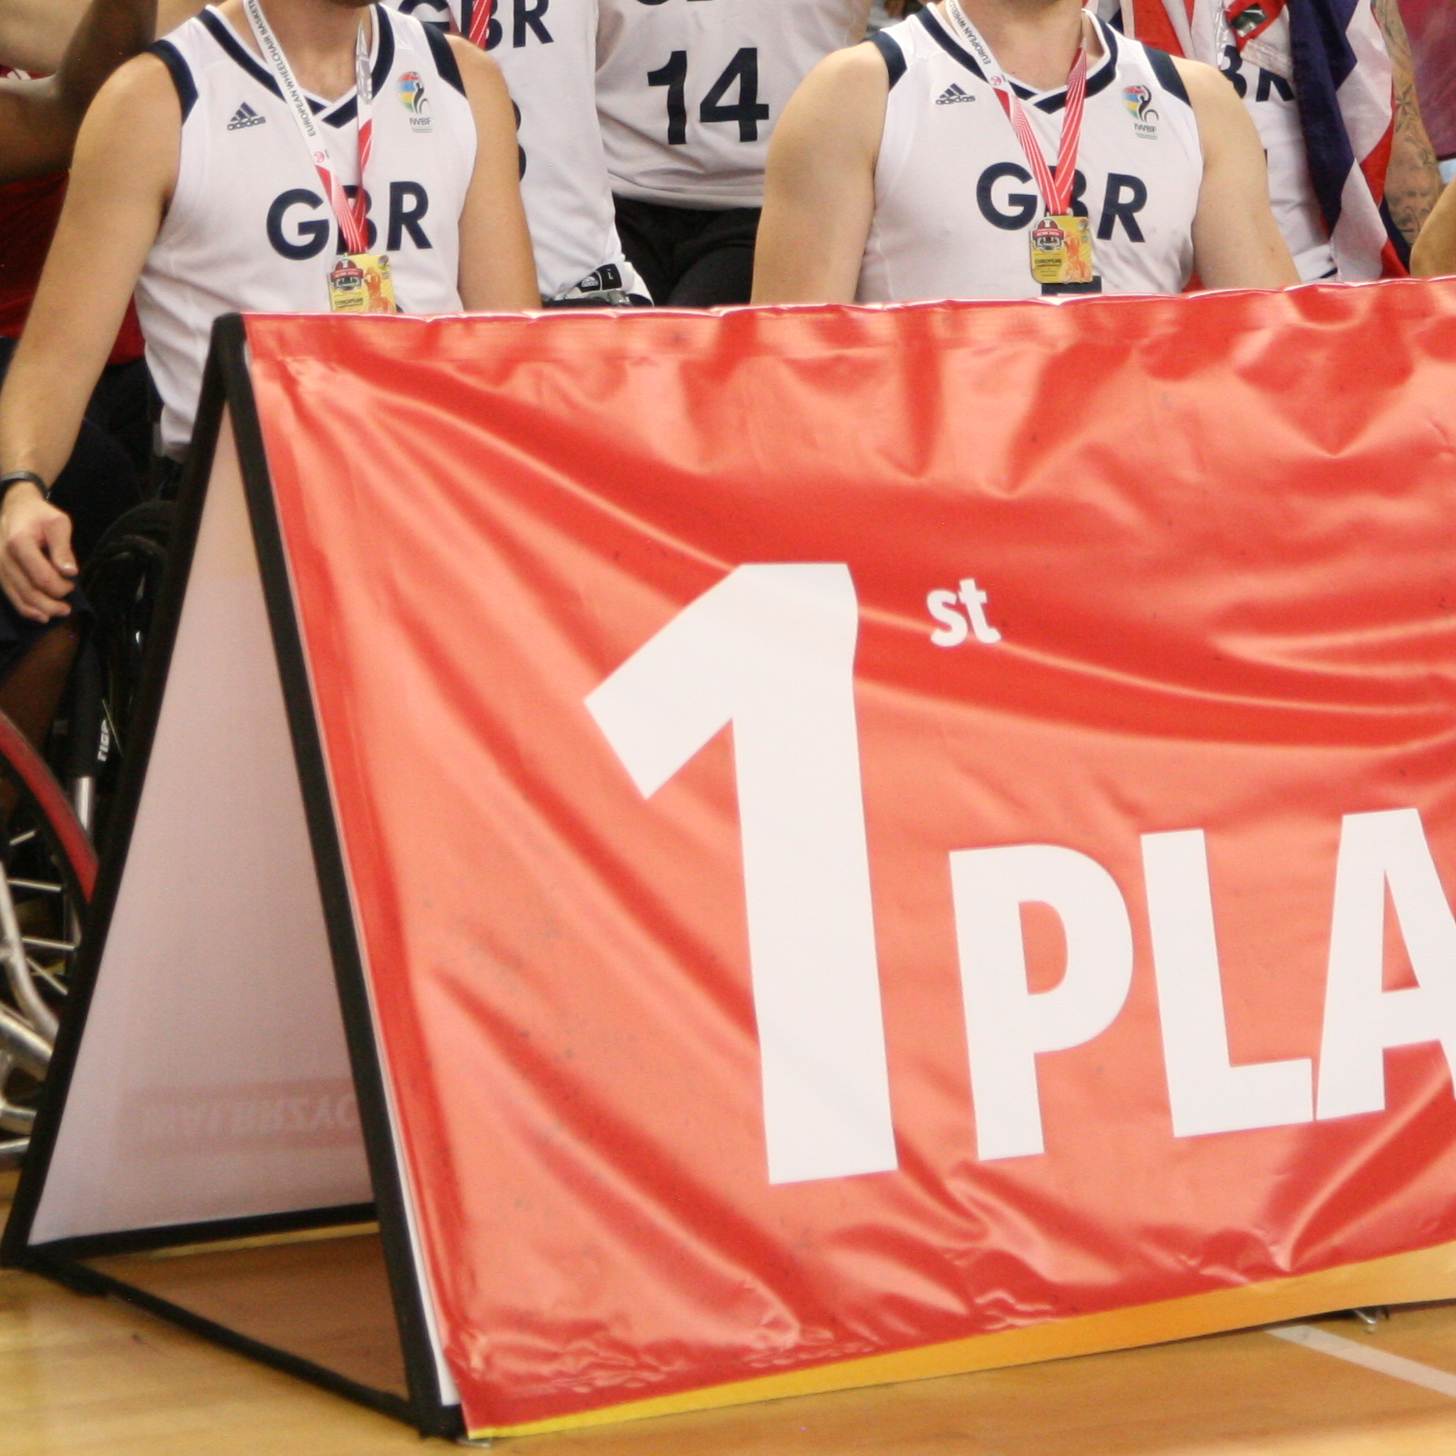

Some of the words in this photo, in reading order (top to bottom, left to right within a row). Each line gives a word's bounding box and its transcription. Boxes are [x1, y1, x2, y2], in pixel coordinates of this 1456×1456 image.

[264, 40, 297, 91] WHEELCHAIR
[963, 27, 993, 66] EUROPEAN
[647, 47, 770, 145] 14
[1223, 44, 1296, 102] BR
[226, 115, 267, 131] adidas
[287, 87, 317, 138] EUROPEAN
[935, 94, 976, 106] adidas
